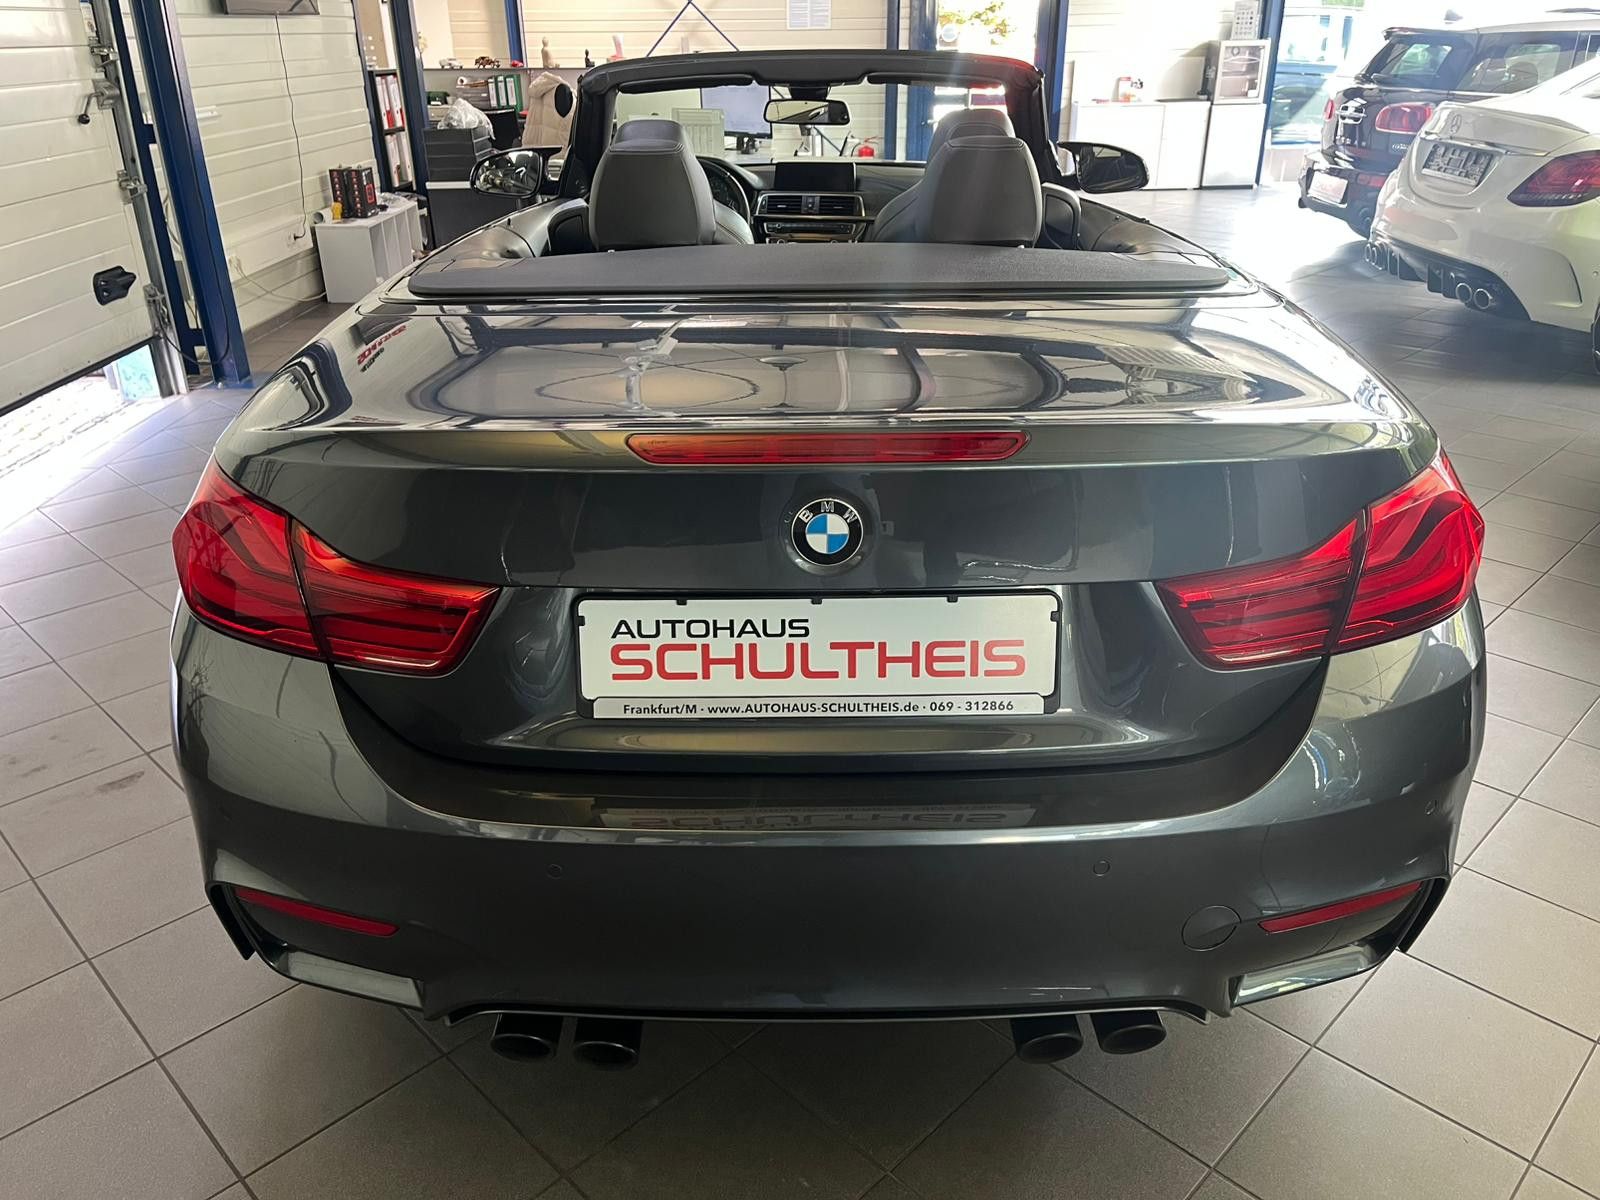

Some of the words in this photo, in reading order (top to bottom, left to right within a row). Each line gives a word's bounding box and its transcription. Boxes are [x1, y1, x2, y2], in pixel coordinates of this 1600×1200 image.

[798, 501, 858, 523] BMW
[611, 619, 810, 638] AUTOHAUS
[610, 640, 1026, 680] SCHULTHEIS
[623, 704, 697, 715] Frankfurt/M
[707, 703, 919, 714] www.AUTOHAUS-SCHULTHEIS.de
[930, 701, 954, 712] 069
[965, 701, 1014, 711] 312866
